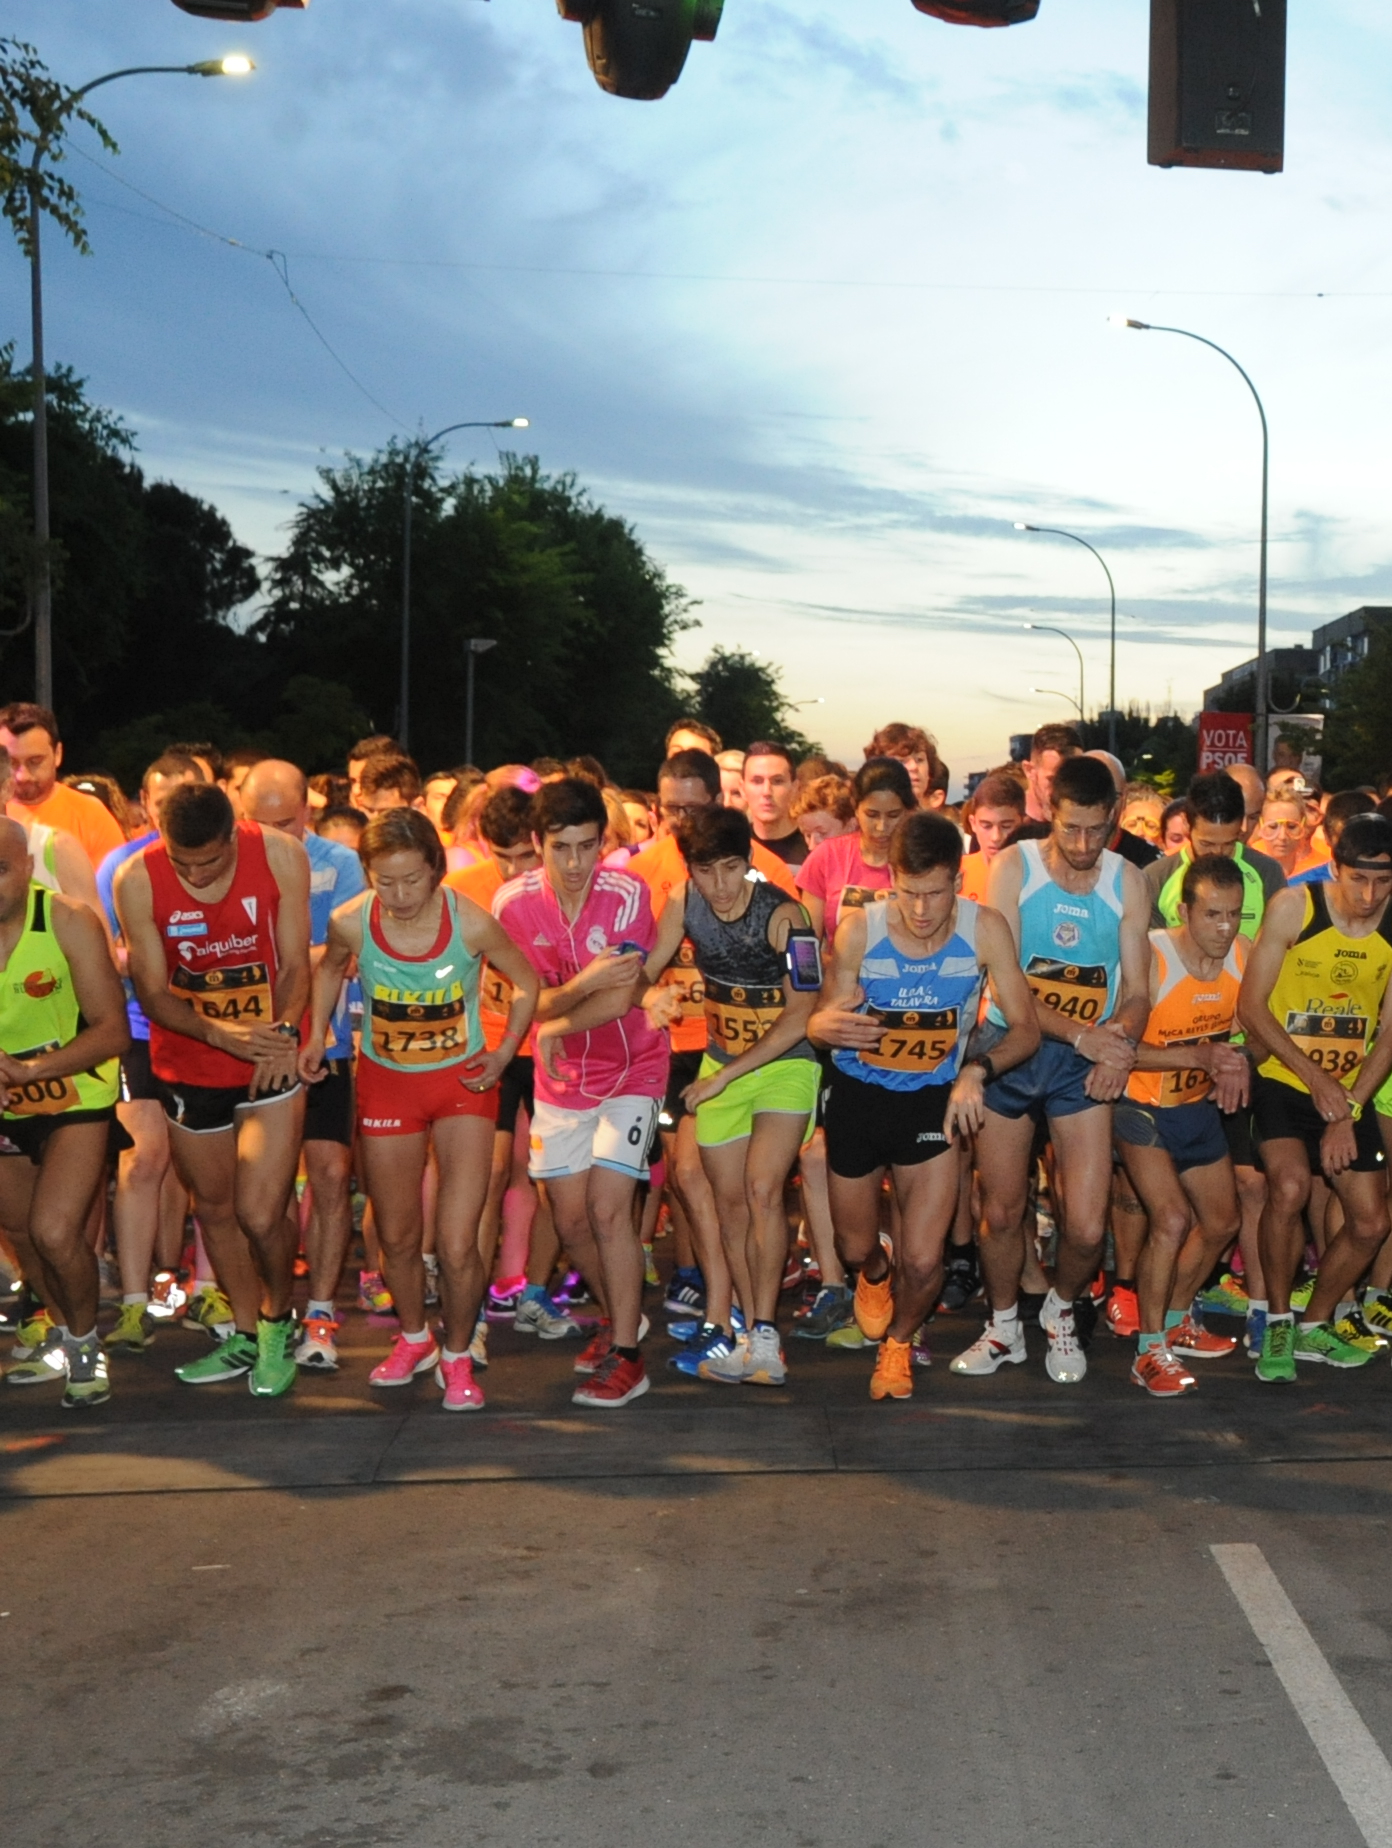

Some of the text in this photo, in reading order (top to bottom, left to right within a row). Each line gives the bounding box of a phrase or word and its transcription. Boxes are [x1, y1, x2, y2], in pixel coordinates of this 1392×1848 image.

[1202, 729, 1247, 748] VOTA
[1305, 997, 1362, 1016] Reale
[380, 1026, 462, 1052] 1738
